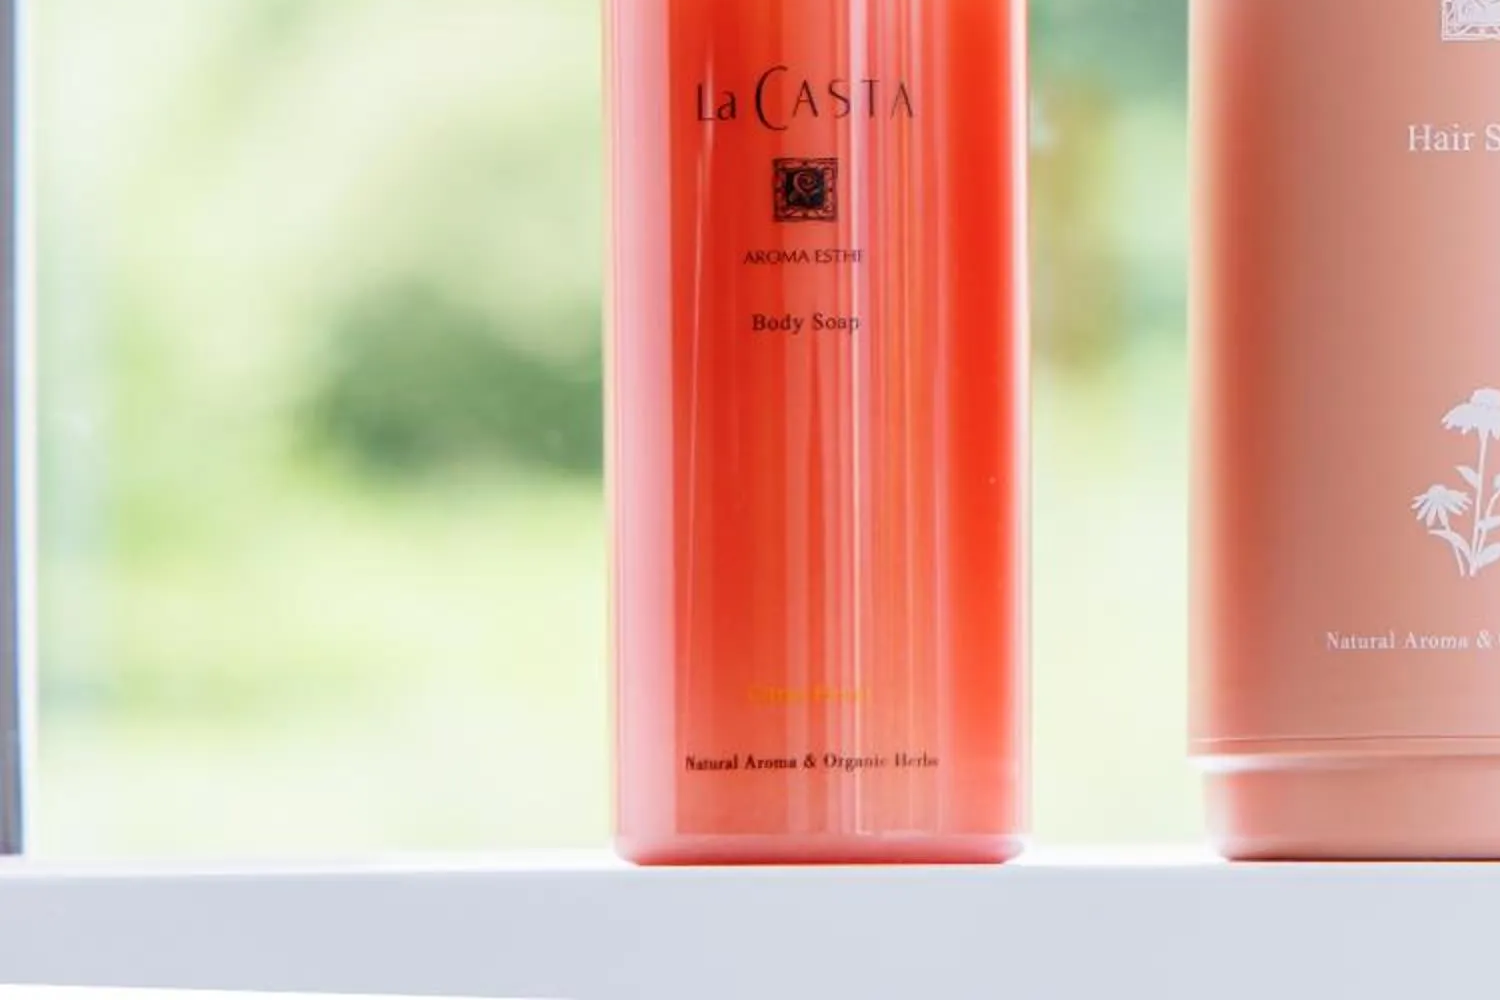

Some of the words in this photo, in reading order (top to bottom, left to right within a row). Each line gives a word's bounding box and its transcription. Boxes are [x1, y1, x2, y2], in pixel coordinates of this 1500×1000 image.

[696, 83, 736, 121] La
[755, 65, 914, 131] CASTA
[1407, 122, 1475, 153] Hair
[743, 248, 810, 265] AROMA
[752, 313, 804, 335] Body
[812, 312, 860, 335] Soap
[1326, 630, 1396, 650] Natural
[1404, 631, 1468, 649] Aroma
[1476, 630, 1493, 649] &
[685, 754, 738, 771] Natural
[744, 755, 797, 769] Aroma
[803, 754, 816, 769] &
[823, 752, 887, 772] Organic
